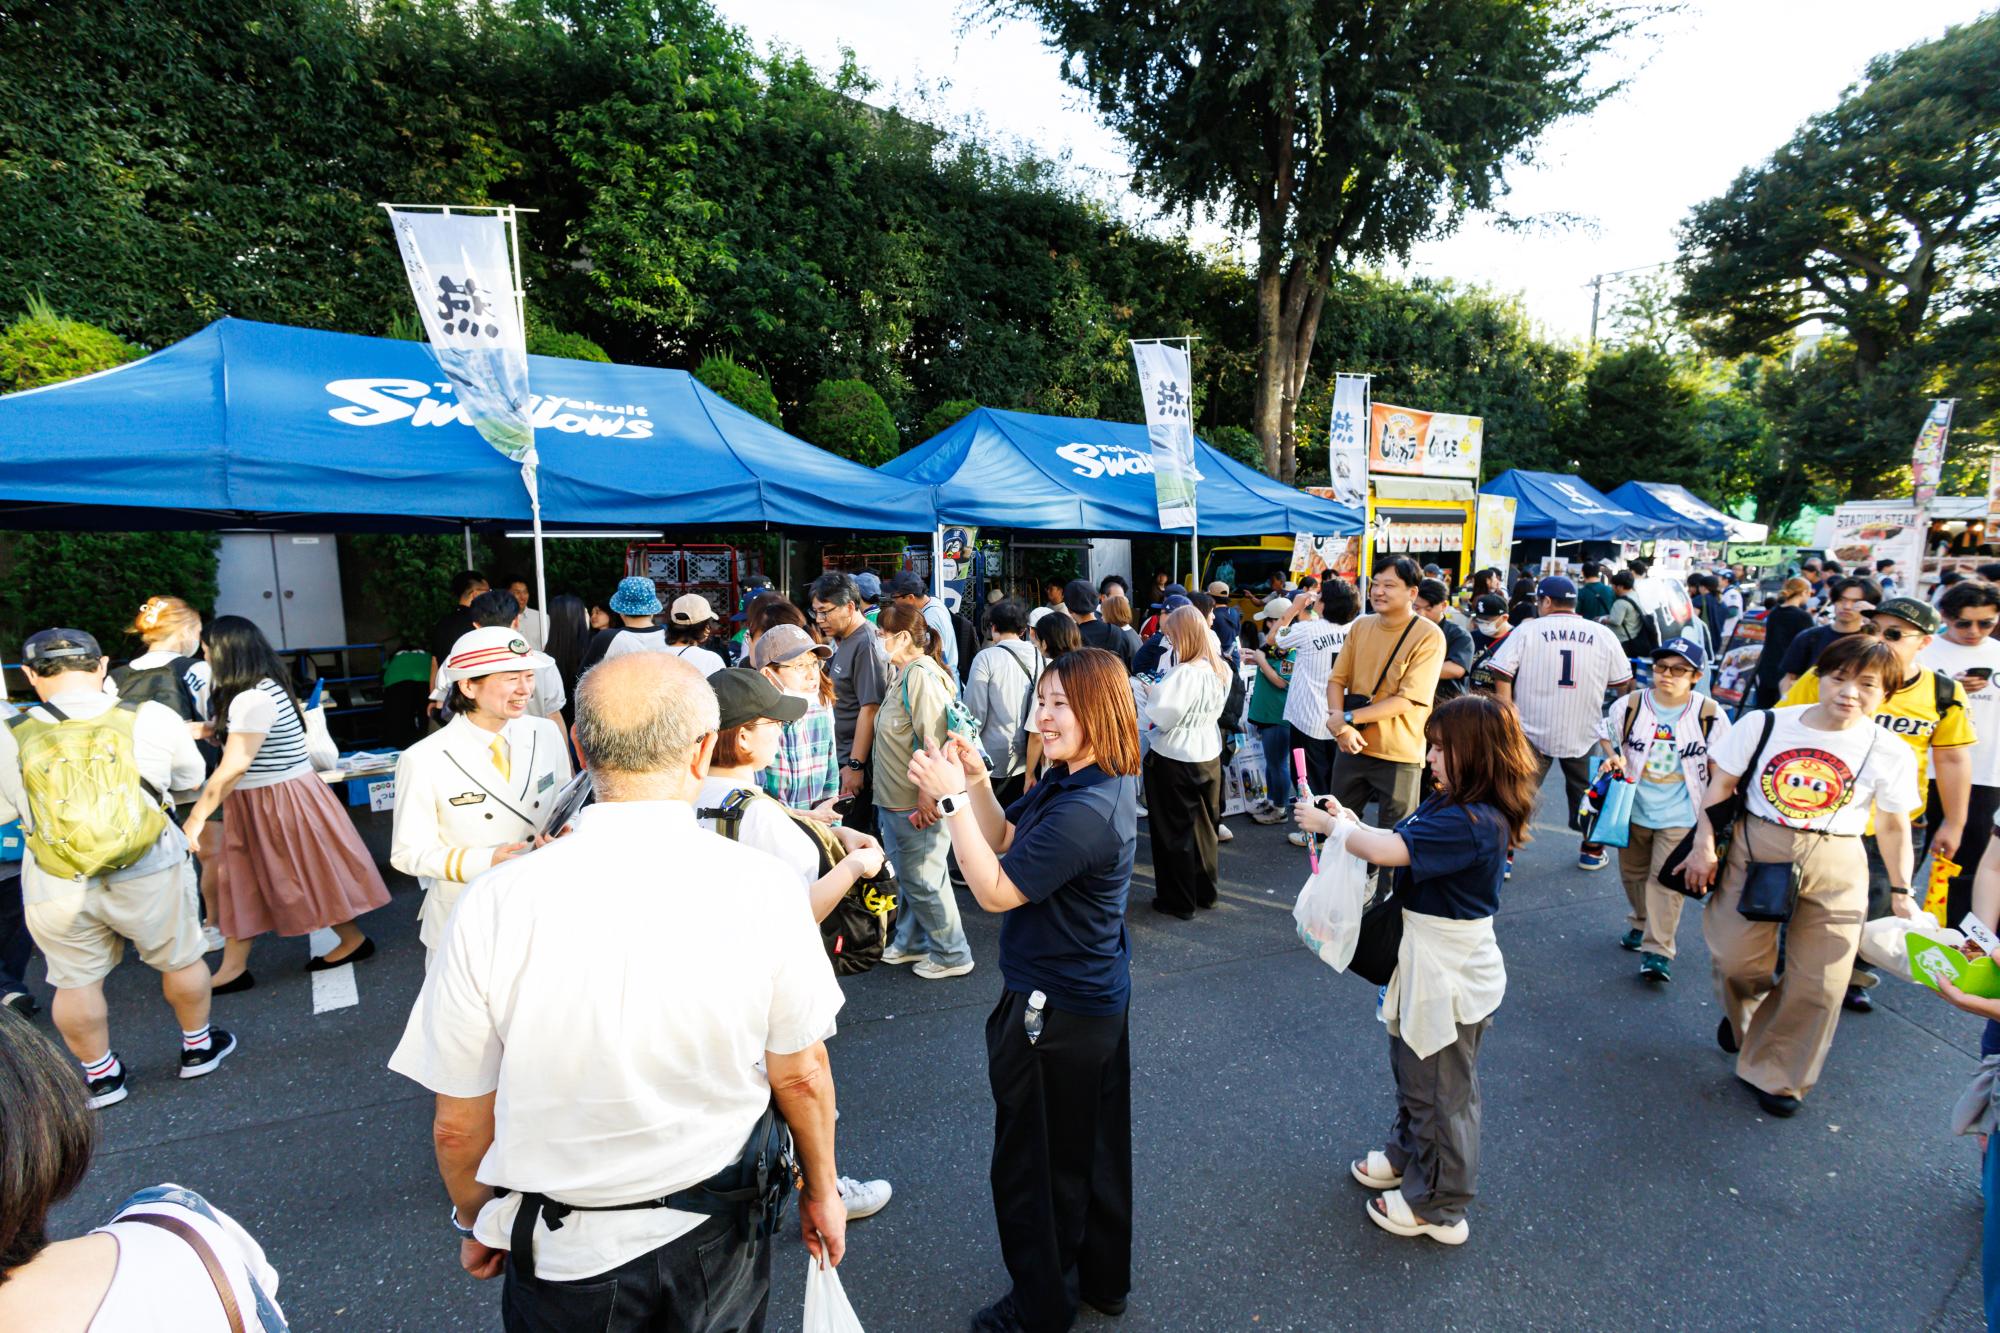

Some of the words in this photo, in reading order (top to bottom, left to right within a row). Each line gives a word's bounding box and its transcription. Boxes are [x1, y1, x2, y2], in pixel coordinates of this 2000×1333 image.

[545, 394, 648, 417] Yakult
[1157, 380, 1187, 418] 燕
[1836, 514, 1882, 528] STADIUM
[1885, 513, 1916, 527] STEAK
[1542, 630, 1594, 646] YAMADA
[1558, 650, 1577, 688] 1
